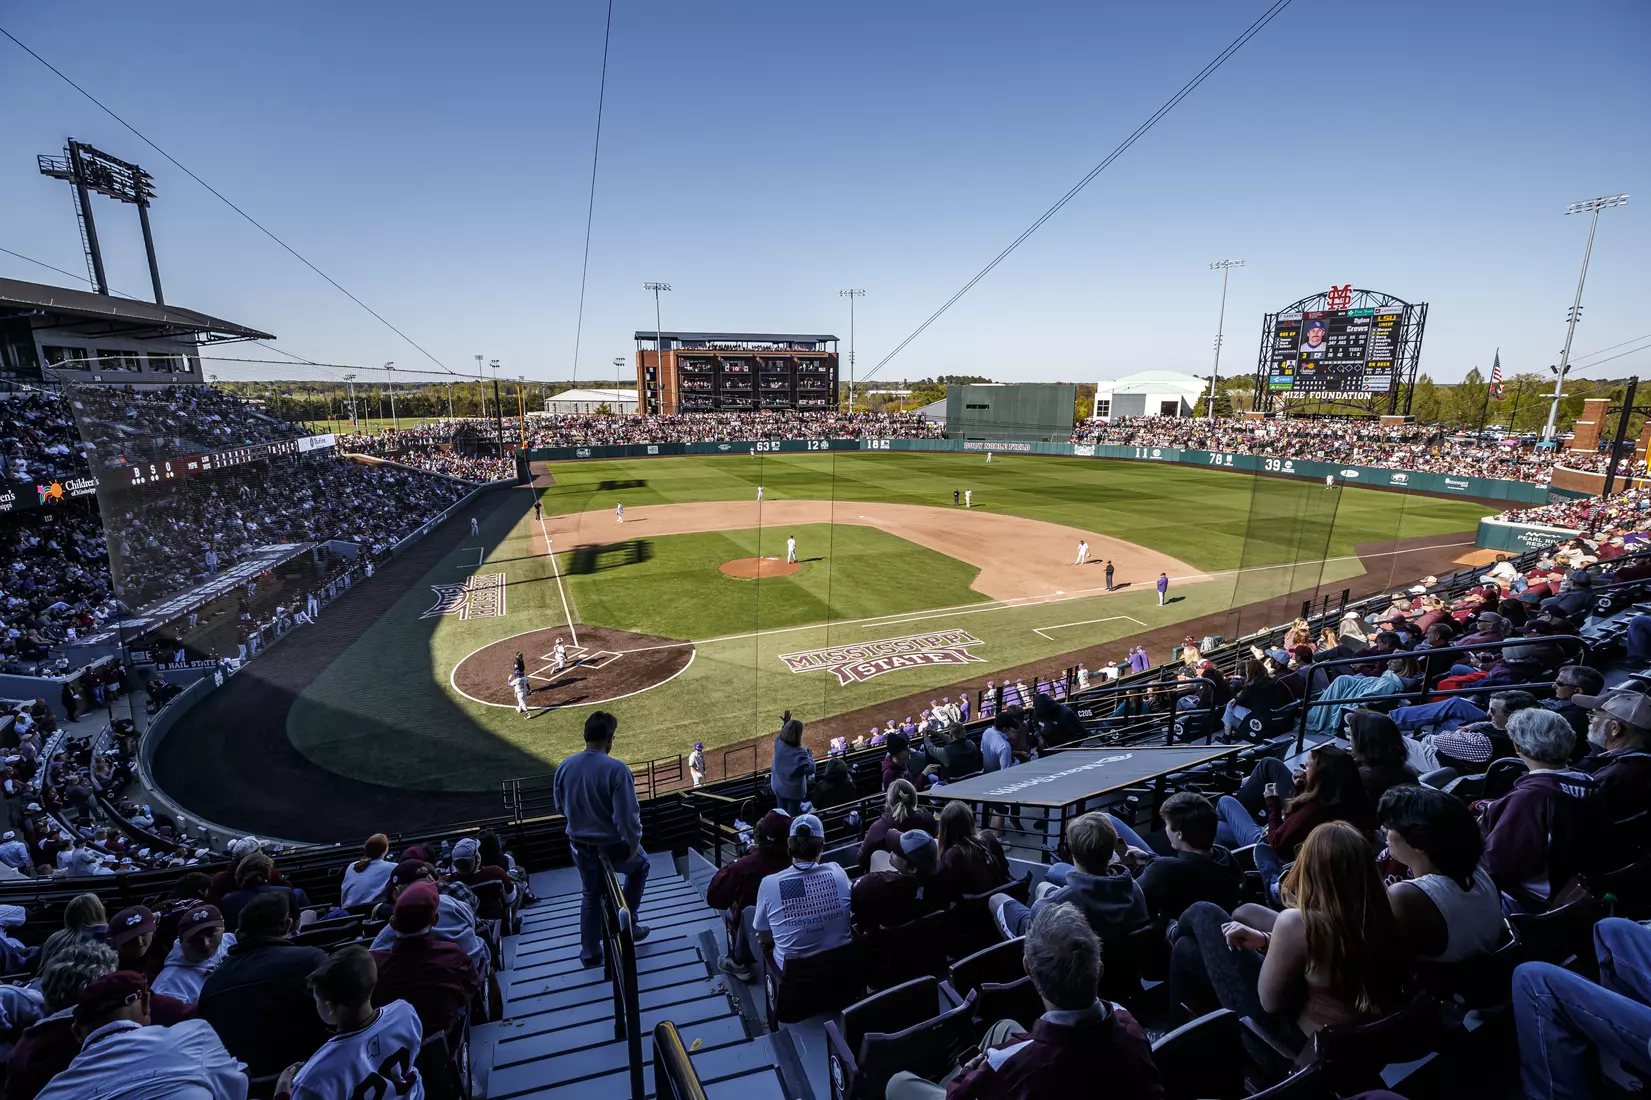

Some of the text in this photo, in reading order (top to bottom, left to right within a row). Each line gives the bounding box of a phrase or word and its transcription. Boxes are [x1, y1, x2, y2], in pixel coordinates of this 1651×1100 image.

[1310, 391, 1372, 400] FOUNDATION
[756, 442, 769, 450] 63
[808, 441, 818, 450] 12
[867, 440, 878, 449] 18
[1135, 448, 1148, 457] 11
[1209, 453, 1222, 464] 78
[134, 467, 140, 477] B
[150, 464, 156, 474] S
[1265, 459, 1281, 471] 39
[65, 476, 100, 491] Children's
[783, 630, 979, 668] MISSISSIPPI
[169, 660, 216, 669] HAIL STATE
[857, 652, 946, 676] STATE
[783, 911, 844, 928] vineyard vines
